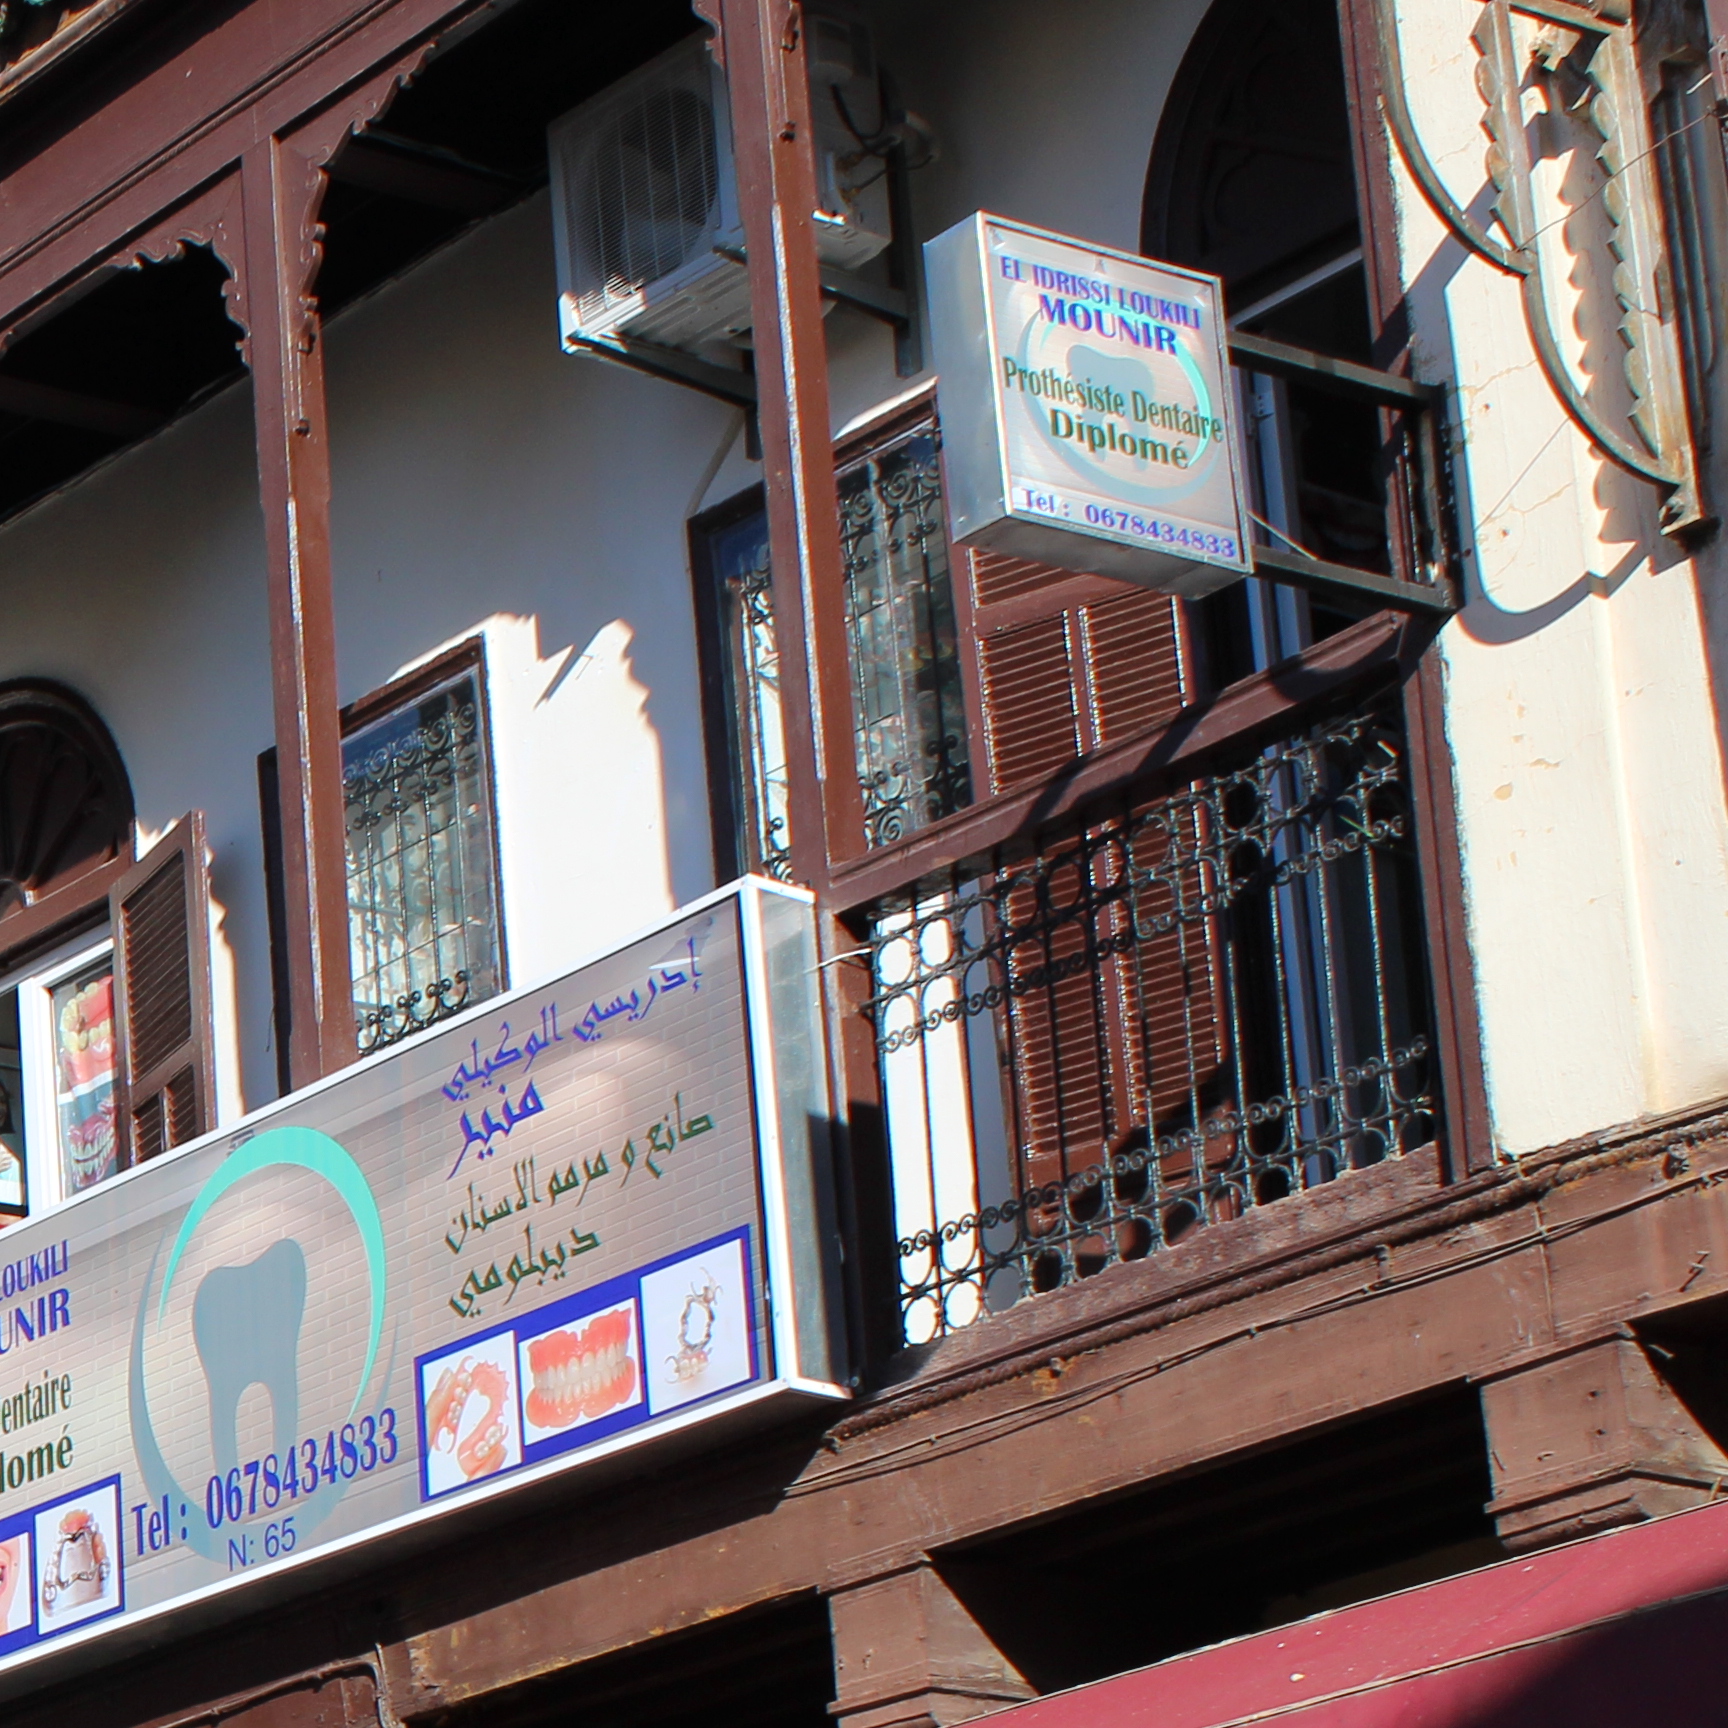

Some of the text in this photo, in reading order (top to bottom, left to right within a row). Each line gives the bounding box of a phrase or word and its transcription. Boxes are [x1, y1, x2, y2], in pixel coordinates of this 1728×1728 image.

[1000, 255, 1201, 329] EL IDRISSI LOUKILI
[1038, 293, 1177, 354] MOUNIR
[1002, 356, 1223, 443] Prothésiste Dentaire
[1049, 408, 1189, 469] Diplomé
[1085, 504, 1236, 558] 0678434833
[442, 936, 703, 1102] إدريسي الوكيلي
[446, 1076, 545, 1180] منير
[645, 1090, 716, 1179] صانع
[444, 1154, 542, 1255] الاسنان
[548, 1149, 610, 1208] مرمم
[449, 1222, 602, 1318] ديبلومي
[205, 1407, 398, 1529] 0678434833
[264, 1516, 296, 1558] 65
